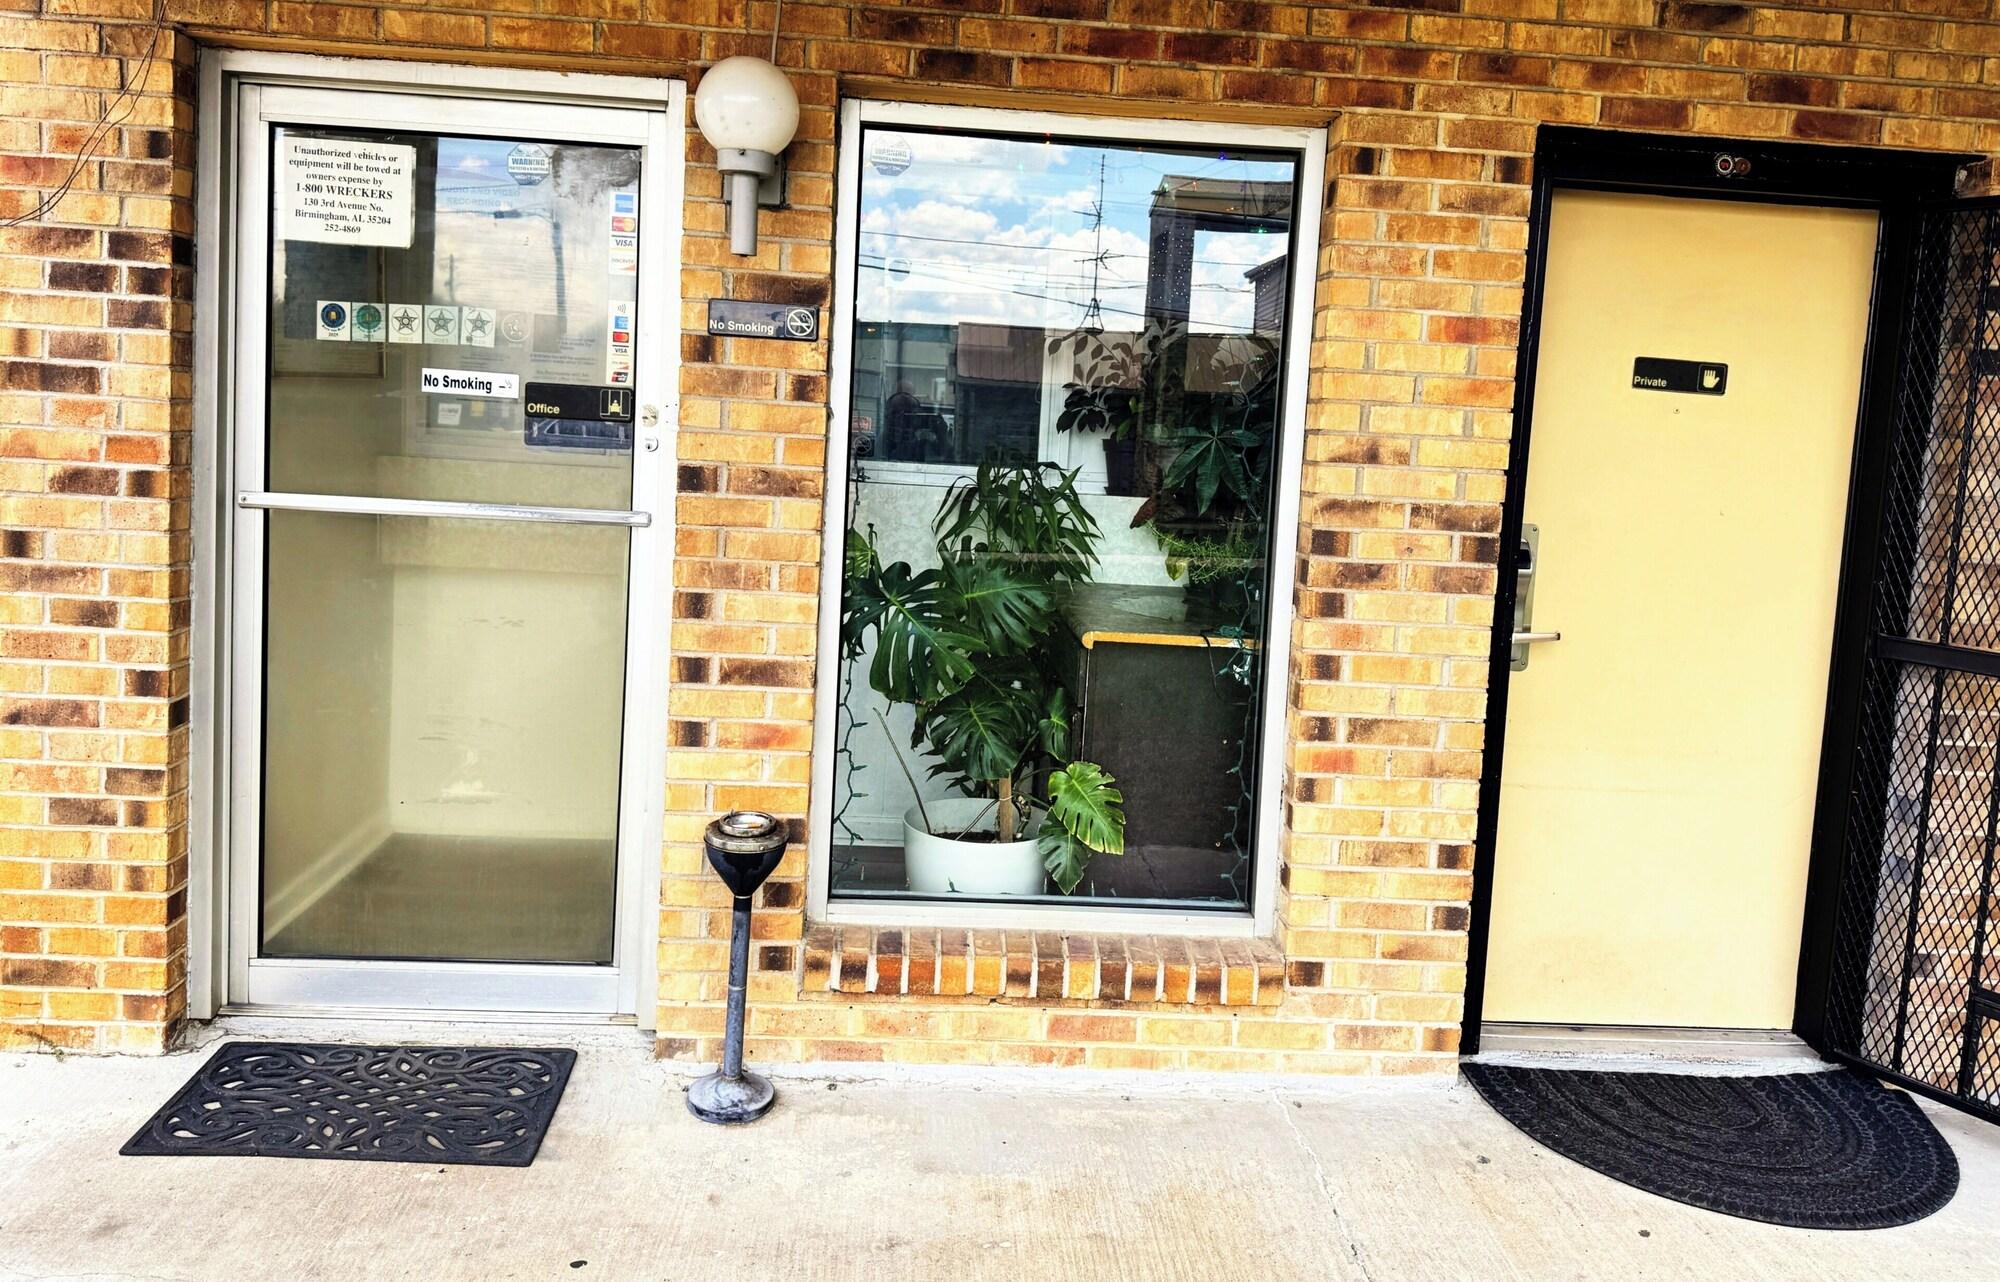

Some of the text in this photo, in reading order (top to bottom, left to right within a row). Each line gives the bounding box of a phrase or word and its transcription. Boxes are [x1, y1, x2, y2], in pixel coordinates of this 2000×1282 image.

[294, 145, 398, 163] Unauthorized vehicles or
[289, 158, 401, 175] equipment will be towed at
[511, 157, 546, 167] WARNING
[306, 173, 384, 187] owners expense by
[296, 182, 393, 200] 1-800 WRECKERS
[304, 197, 384, 212] 130 3rd Avenue No.
[295, 209, 350, 222] Birmingham,
[366, 215, 391, 225] 35204
[324, 223, 361, 234] 252-4869
[615, 239, 633, 247] VISA
[709, 319, 774, 336] No Smoking
[424, 374, 493, 394] No Smoking
[1633, 375, 1668, 388] Private
[527, 402, 561, 415] Office
